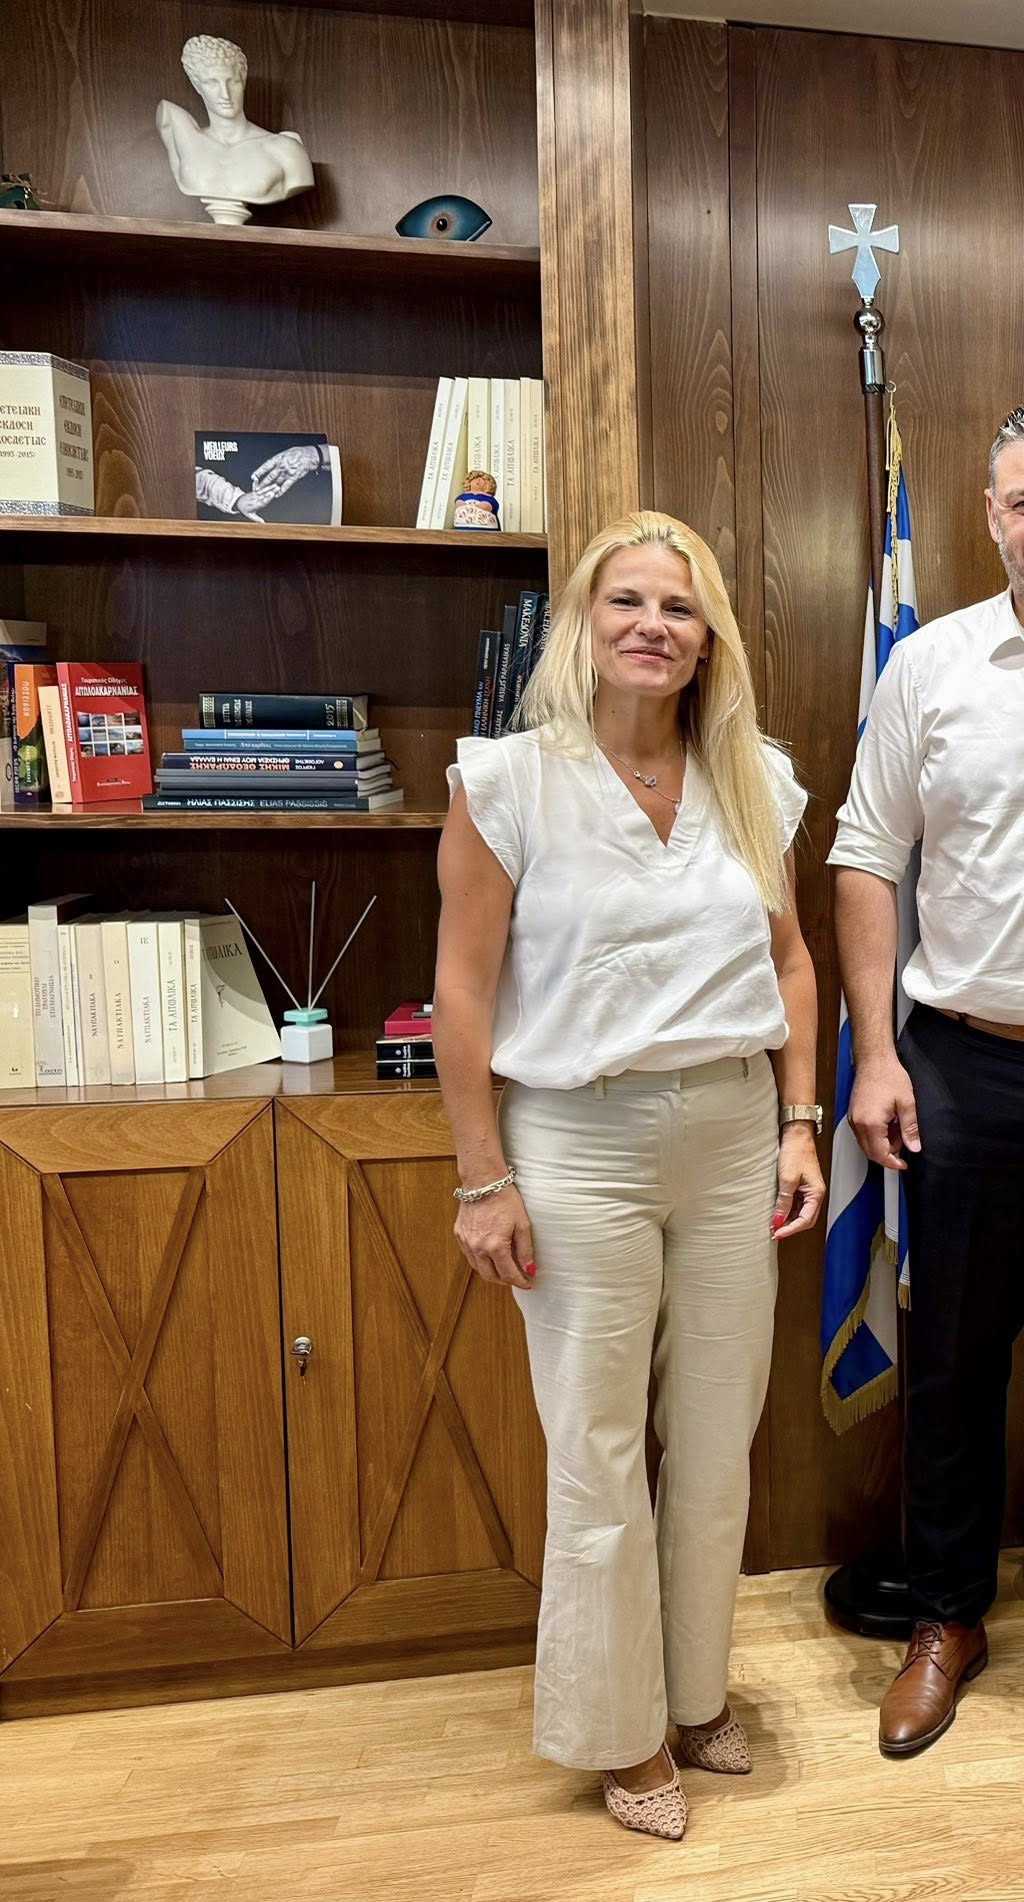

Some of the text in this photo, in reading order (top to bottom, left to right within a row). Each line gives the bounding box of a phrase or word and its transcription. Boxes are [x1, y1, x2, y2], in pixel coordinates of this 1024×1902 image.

[203, 440, 239, 452] MEILLEURS
[203, 450, 226, 461] VOEUX
[74, 686, 139, 697] ΑΙΤΩΛΟΑΚΑΡΝΑΝΙΑΣ
[499, 679, 507, 702] VASILIS
[325, 703, 335, 726] 2015
[187, 798, 212, 806] ΗΛΙΑΣ
[90, 992, 98, 1037] ΝΑΥΠΑΚΤΙΑΚΑ
[166, 979, 178, 1032] ΤΑ ΑΙΤΩΛΙΚΑ
[190, 984, 198, 1023] ΤΑ ΑΙΤΩΛΙΚΑ
[114, 992, 124, 1049] ΝΑΥΠΑΚΤΙΑΚΑ
[142, 996, 152, 1044] ΝΑΥΠΑΚΤΙΑΚΑ
